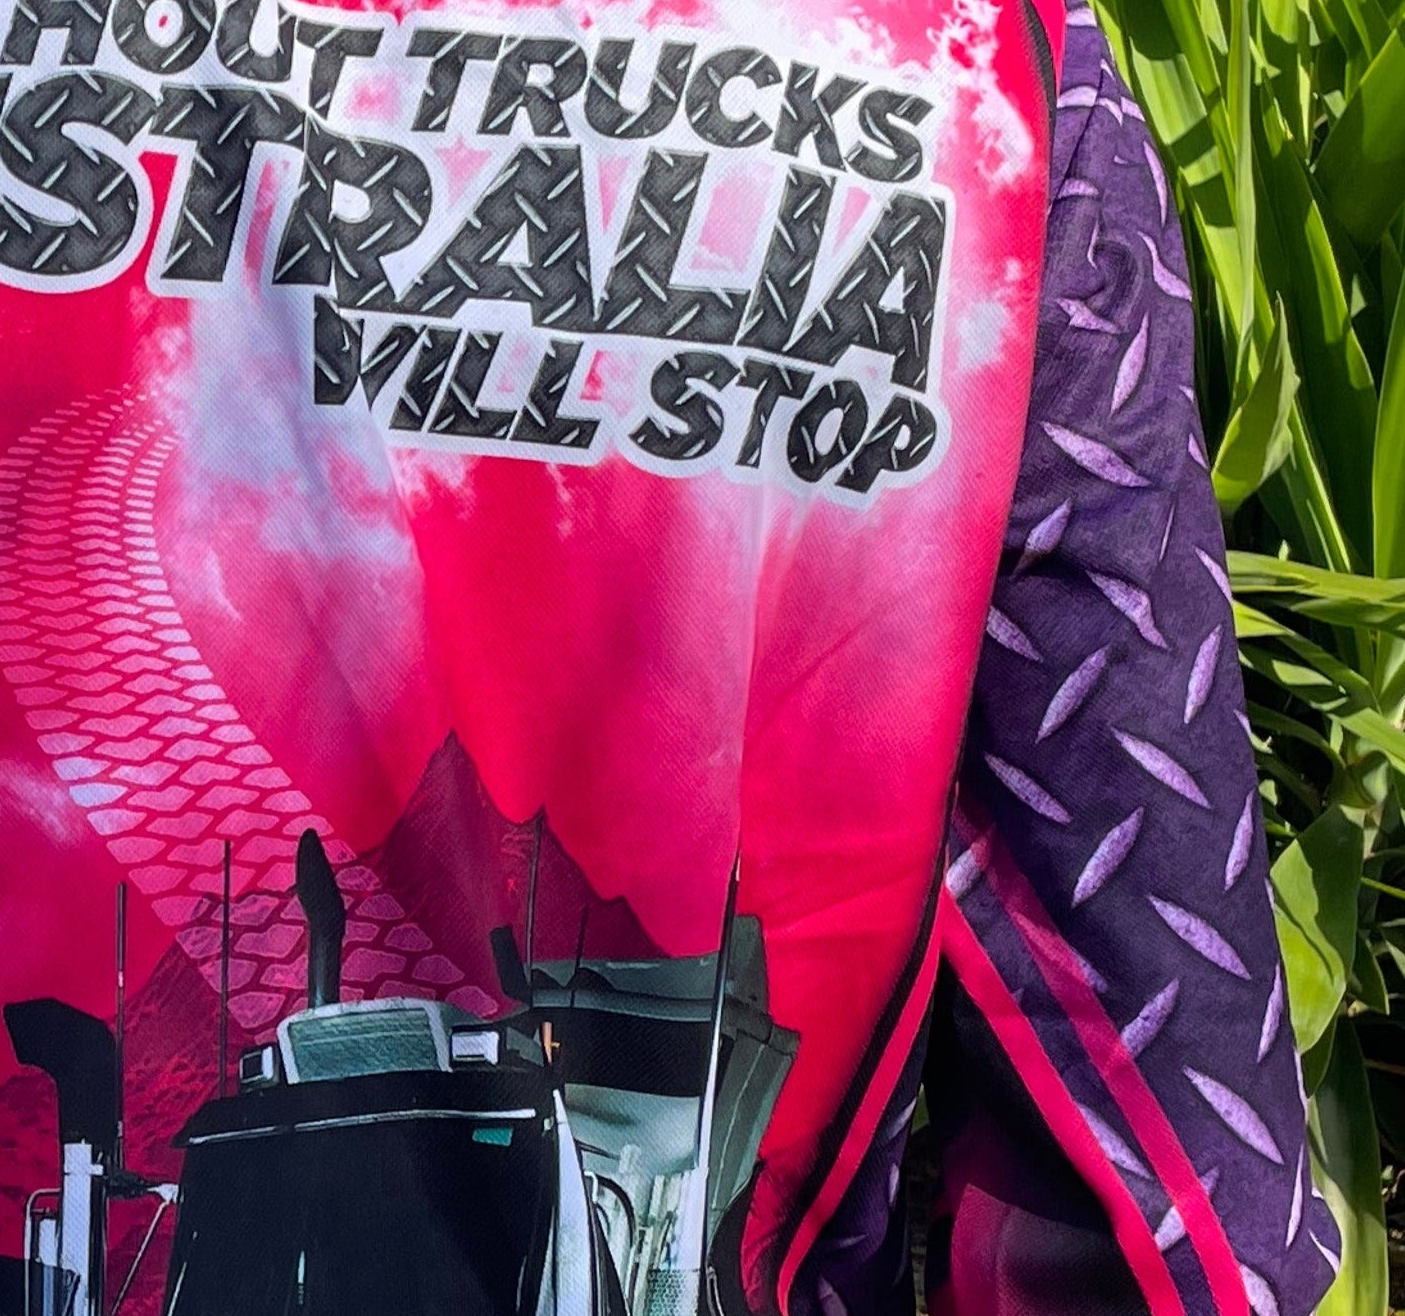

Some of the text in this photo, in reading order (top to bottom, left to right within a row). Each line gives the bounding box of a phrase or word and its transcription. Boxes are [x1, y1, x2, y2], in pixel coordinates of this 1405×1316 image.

[405, 28, 934, 184] TRUCKS
[313, 294, 938, 494] WILL STOP
